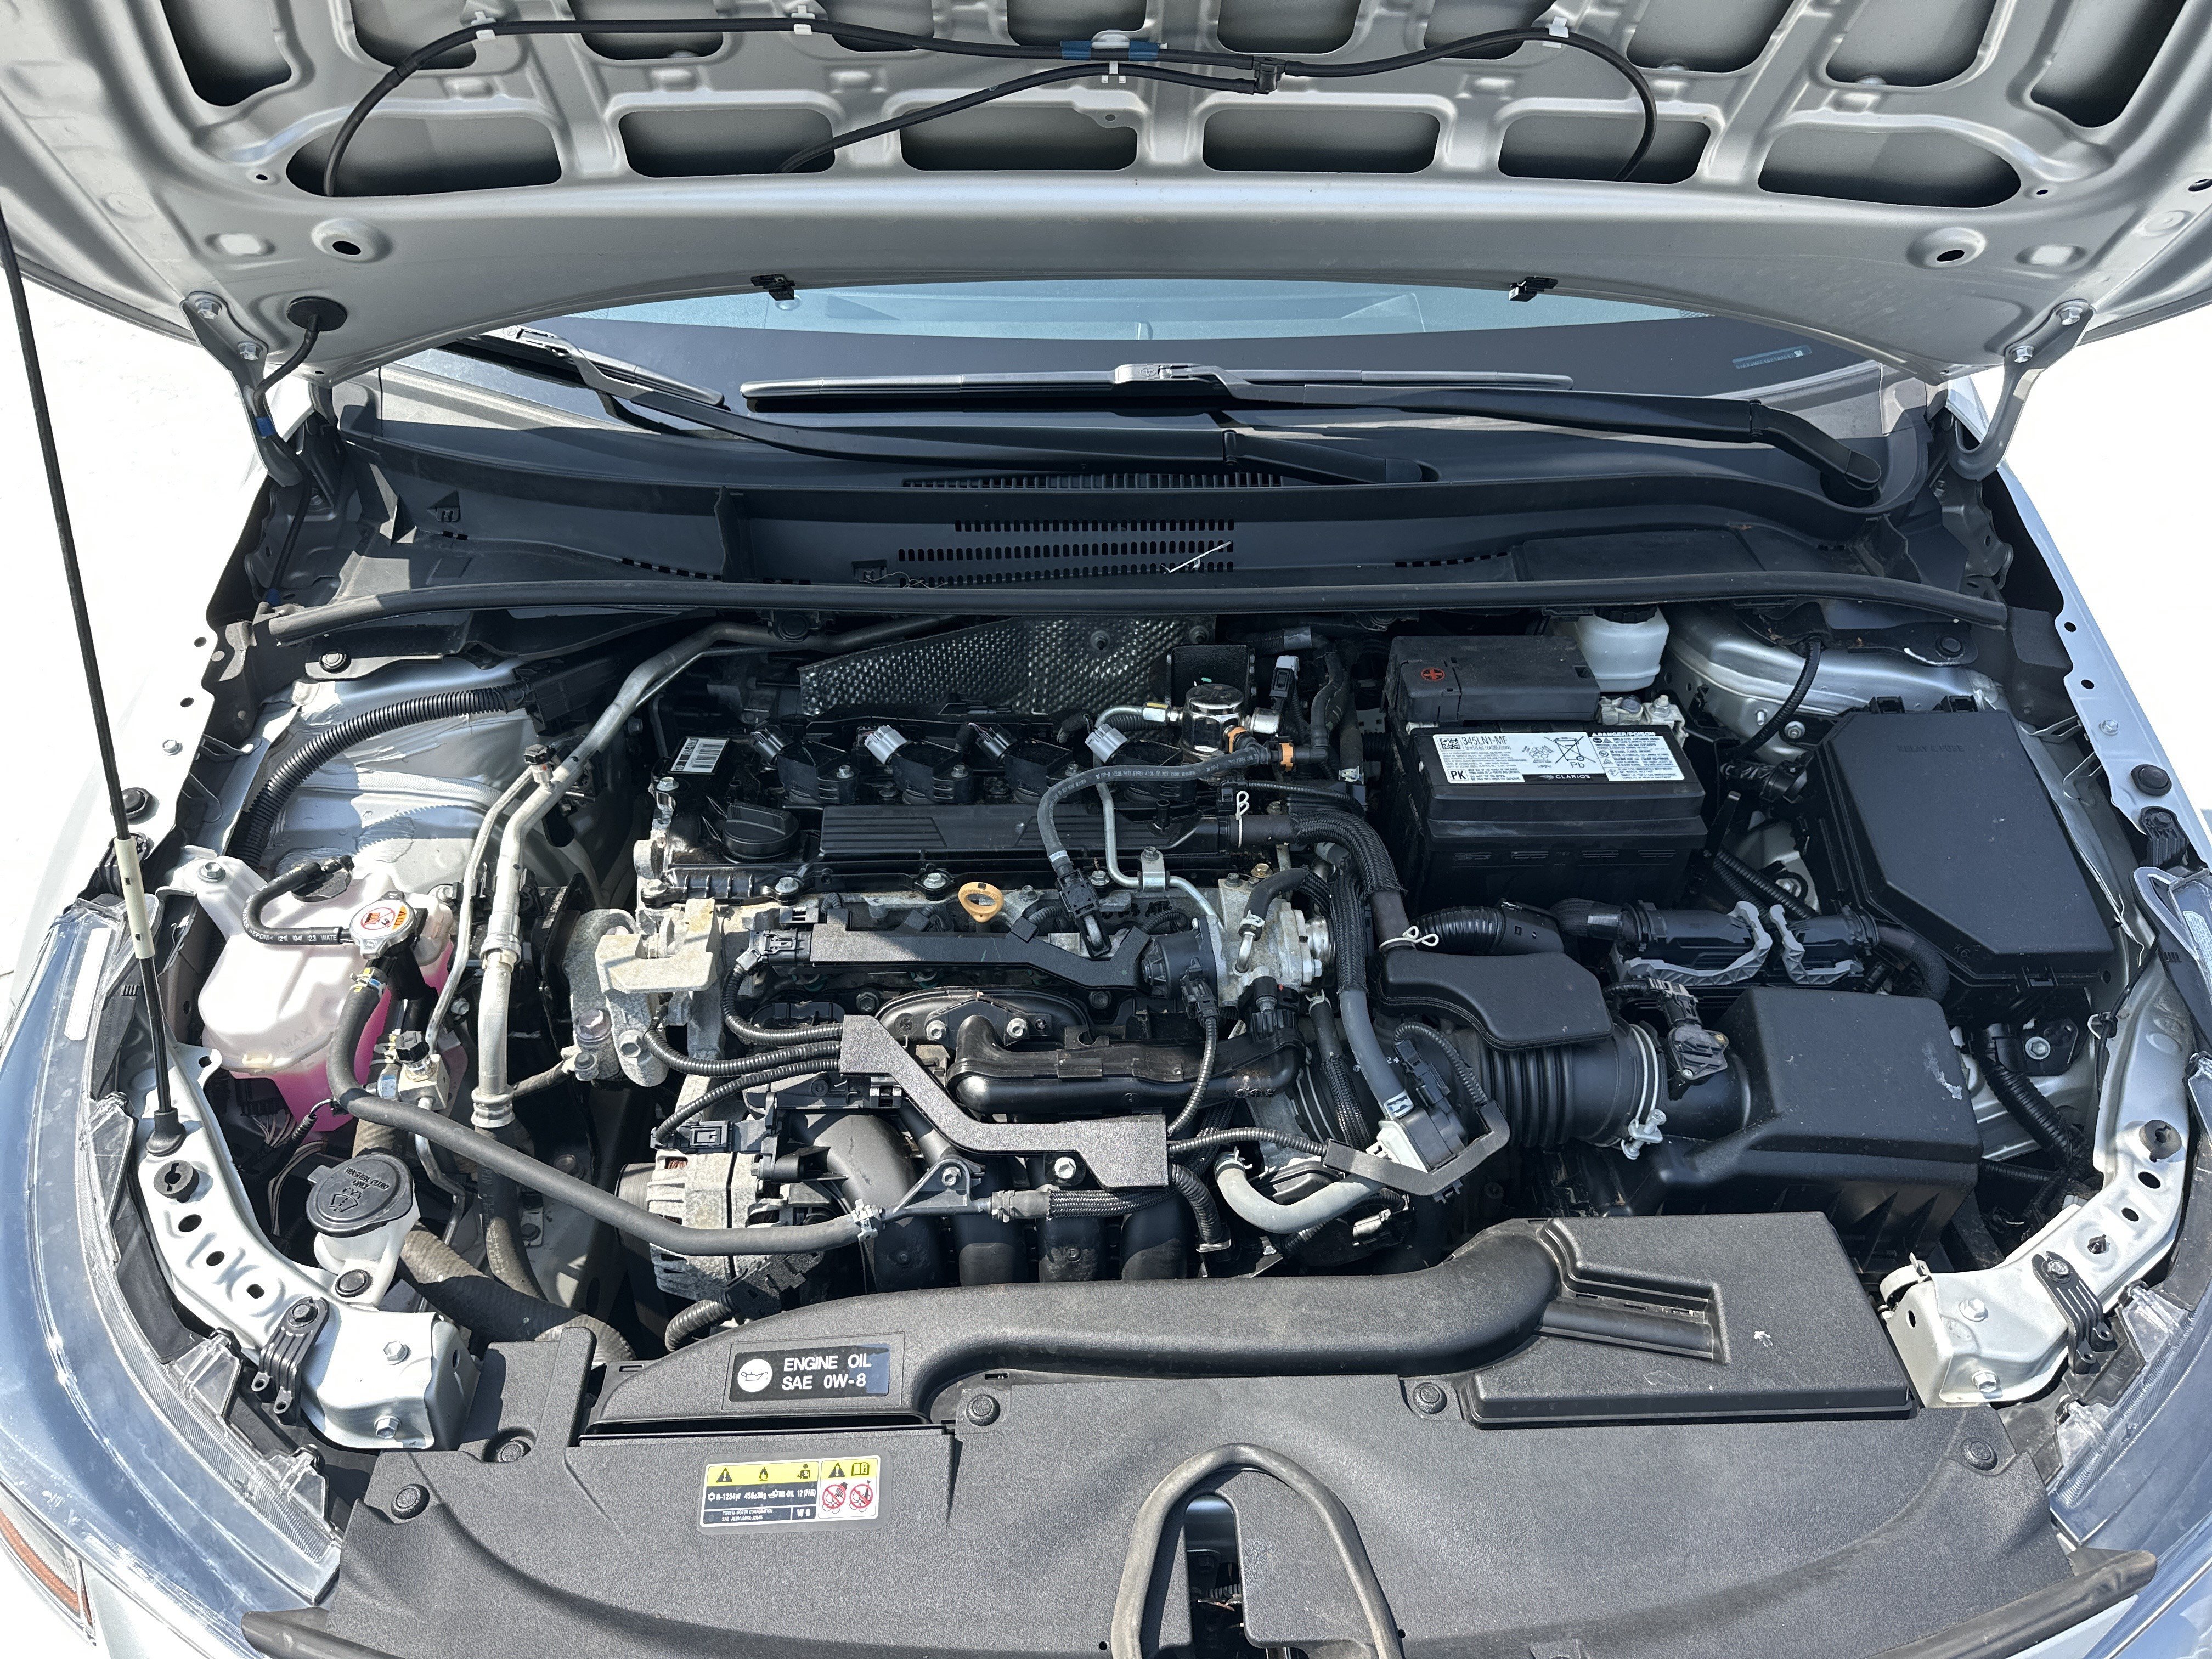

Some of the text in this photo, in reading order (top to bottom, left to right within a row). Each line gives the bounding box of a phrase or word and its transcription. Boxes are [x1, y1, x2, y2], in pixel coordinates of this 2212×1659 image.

[1462, 736, 1508, 746] 345LN1-MF
[1450, 770, 1466, 780] PK
[249, 929, 273, 940] >EPDM<
[280, 1026, 312, 1050] MAX
[345, 1167, 371, 1182] WASHER
[352, 1180, 370, 1190] ONLY
[783, 1353, 872, 1372] ENGINE OIL
[781, 1373, 866, 1390] SAE 0W-8
[716, 1492, 741, 1502] R-1234yf
[797, 1509, 804, 1517] W
